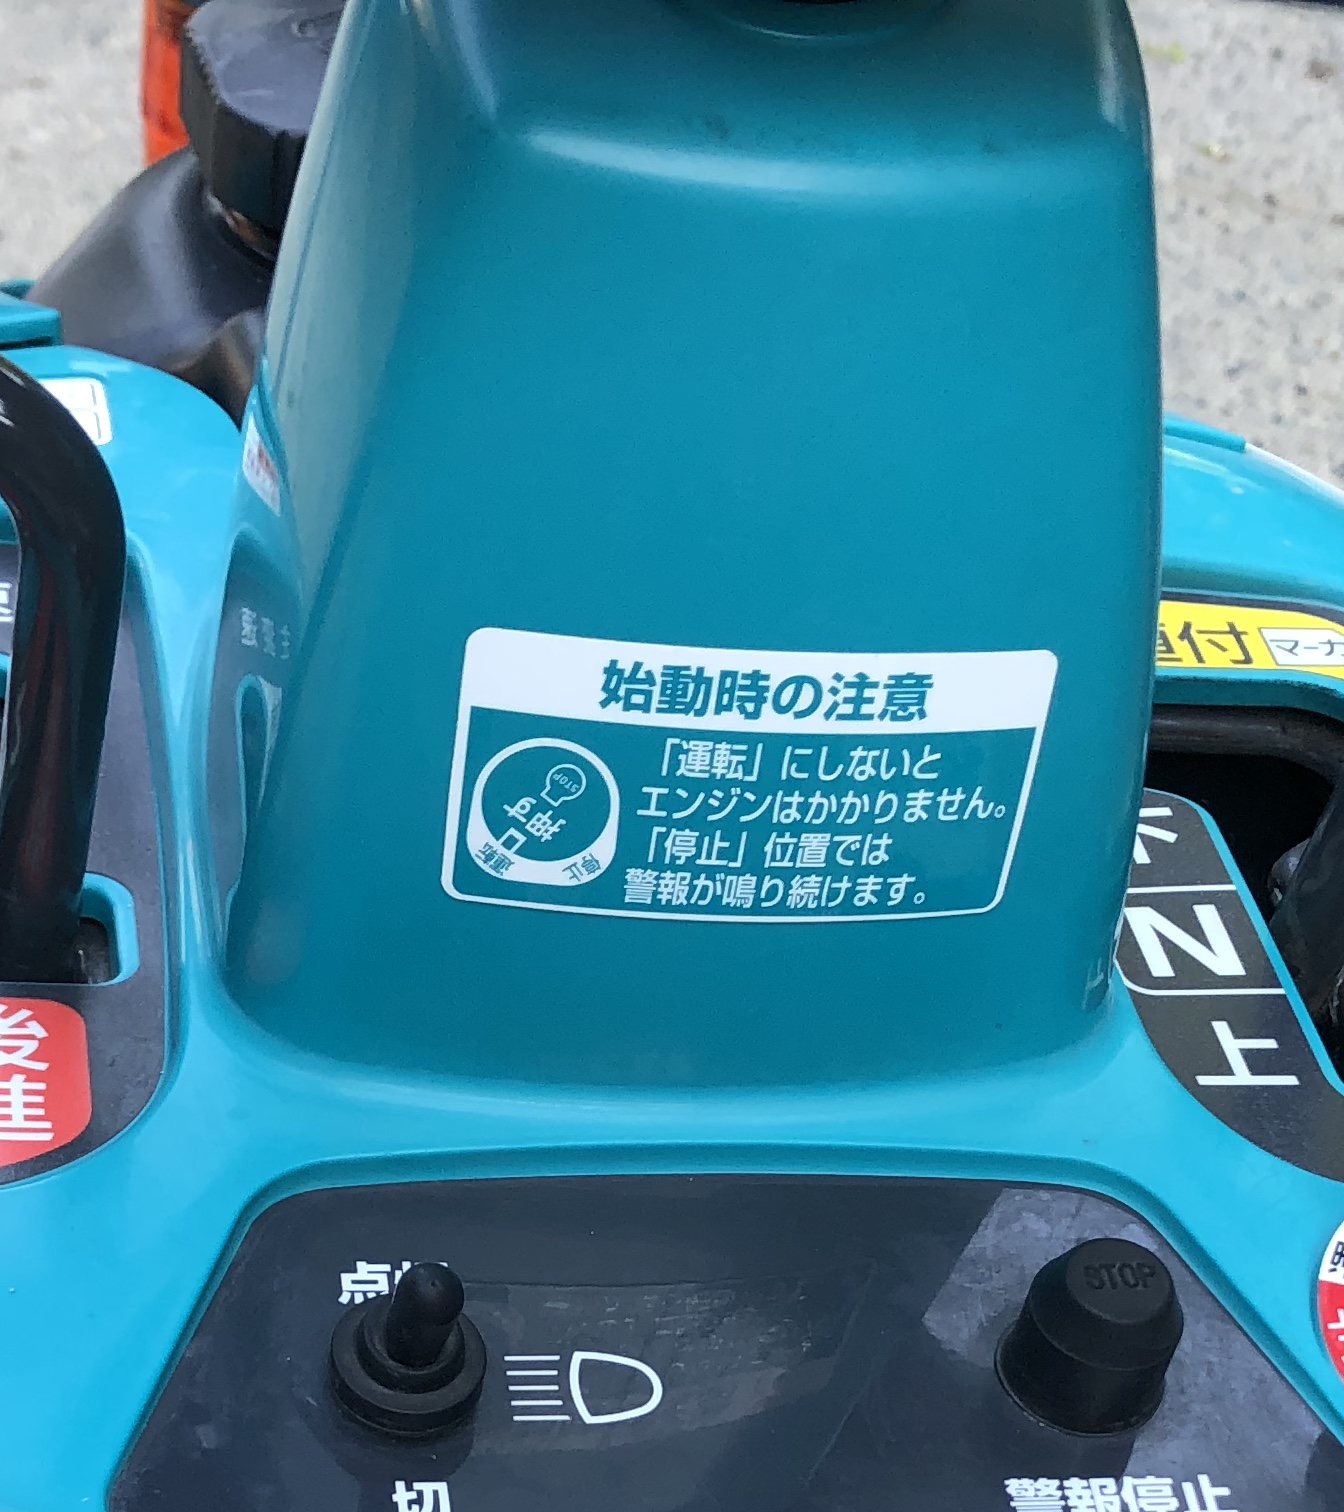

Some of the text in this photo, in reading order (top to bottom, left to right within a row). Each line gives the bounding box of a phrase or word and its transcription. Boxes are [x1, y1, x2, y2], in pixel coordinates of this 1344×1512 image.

[598, 658, 935, 723] 始動時の注意
[636, 785, 1006, 826] エンジンはかかりません。
[623, 866, 926, 910] 警報が鳴り続けます。
[1123, 903, 1247, 977] N
[1195, 1021, 1299, 1086] 上
[1084, 1261, 1157, 1290] STOP
